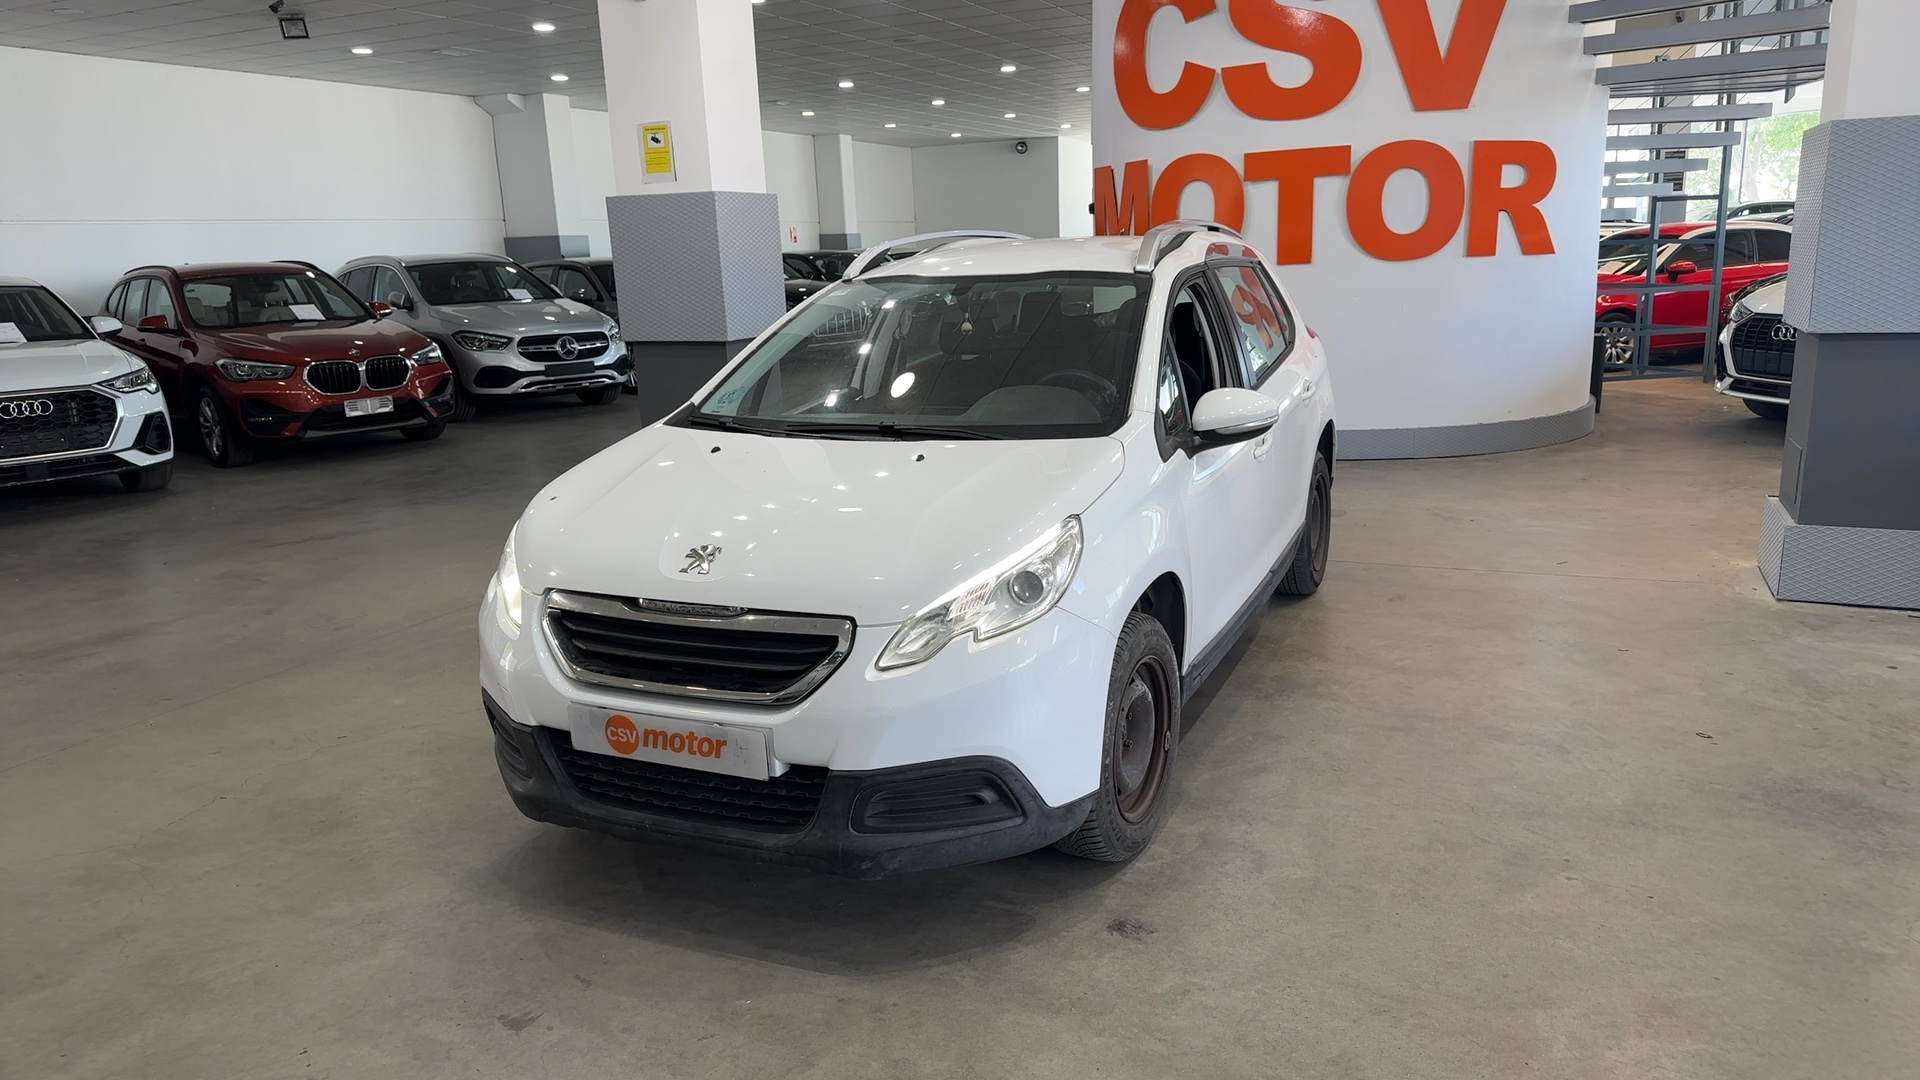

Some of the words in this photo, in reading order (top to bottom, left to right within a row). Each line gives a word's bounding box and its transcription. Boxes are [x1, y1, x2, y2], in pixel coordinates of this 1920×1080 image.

[1113, 0, 1507, 130] CSV
[1094, 139, 1557, 265] MOTOR
[607, 727, 637, 743] CSV
[643, 728, 727, 758] motor
